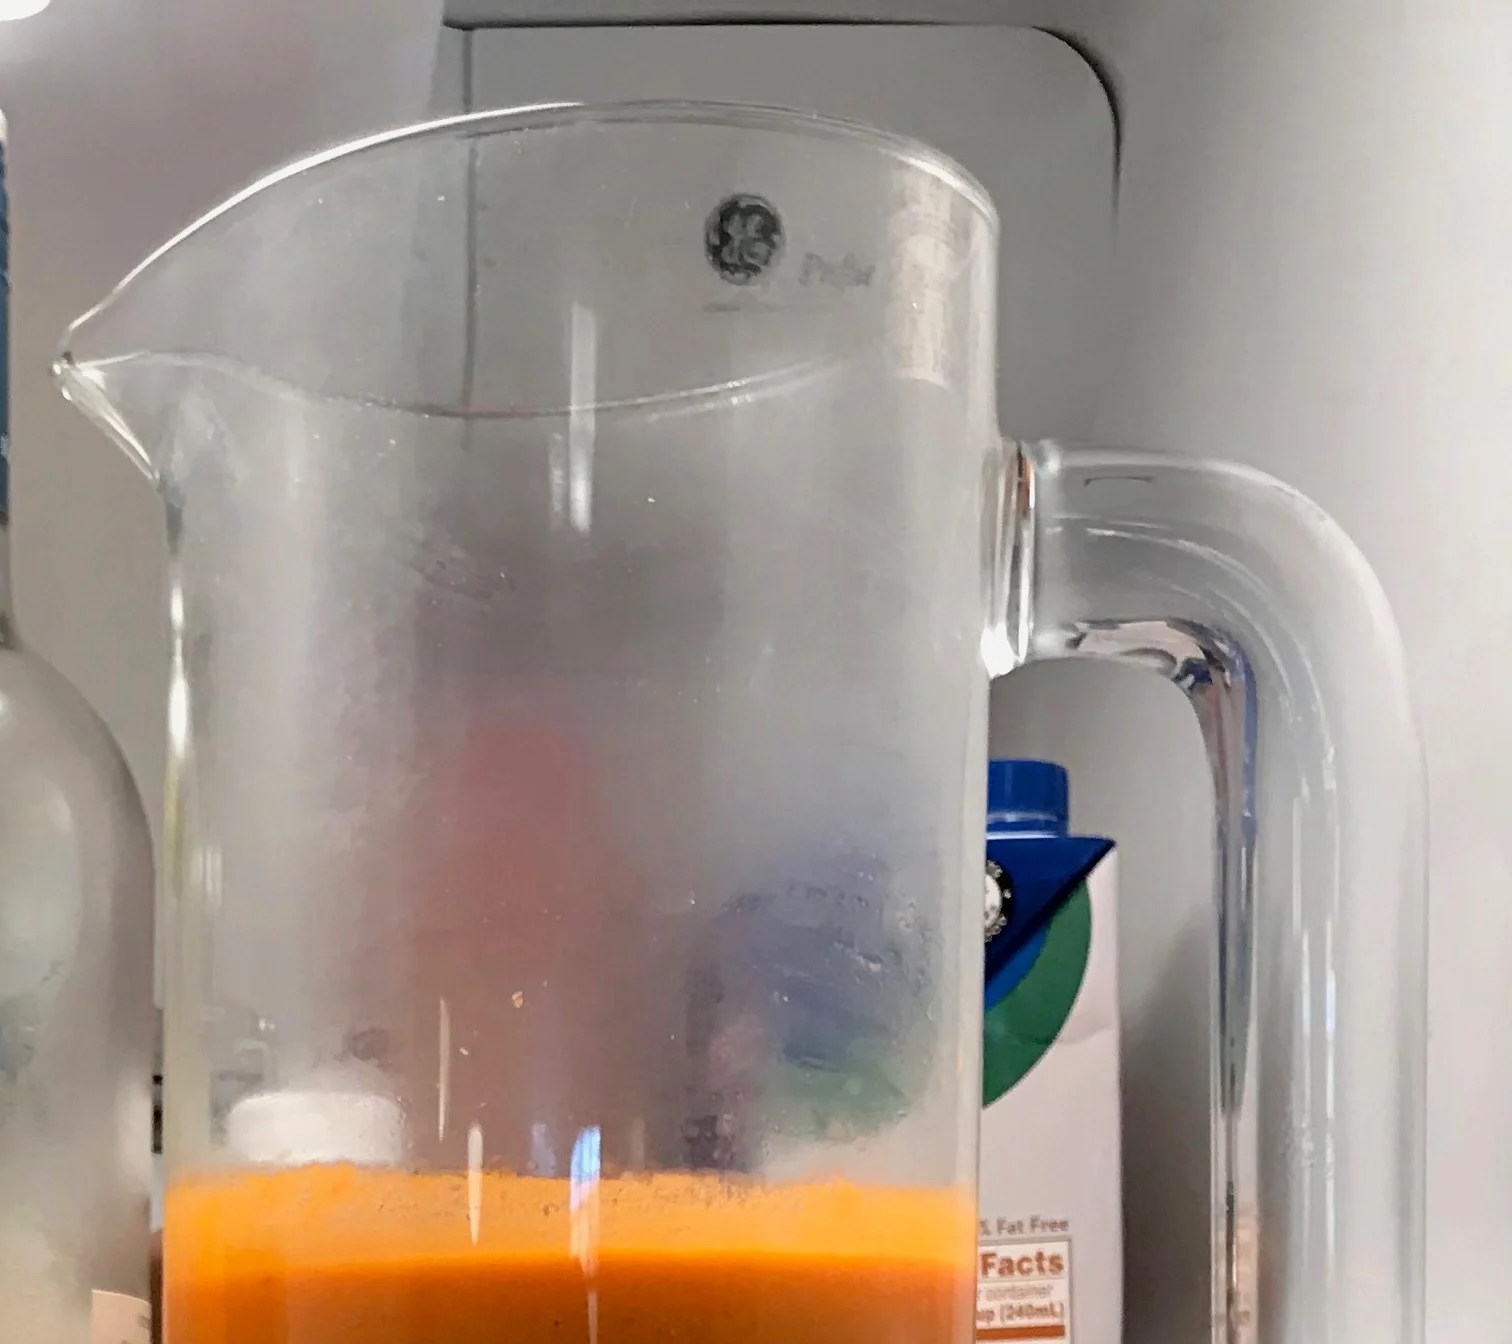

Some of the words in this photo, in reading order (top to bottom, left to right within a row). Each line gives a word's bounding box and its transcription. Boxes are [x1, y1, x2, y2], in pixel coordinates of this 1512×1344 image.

[996, 1217, 1025, 1235] Fat
[1030, 1214, 1069, 1233] Free
[980, 1251, 1065, 1277] Facts
